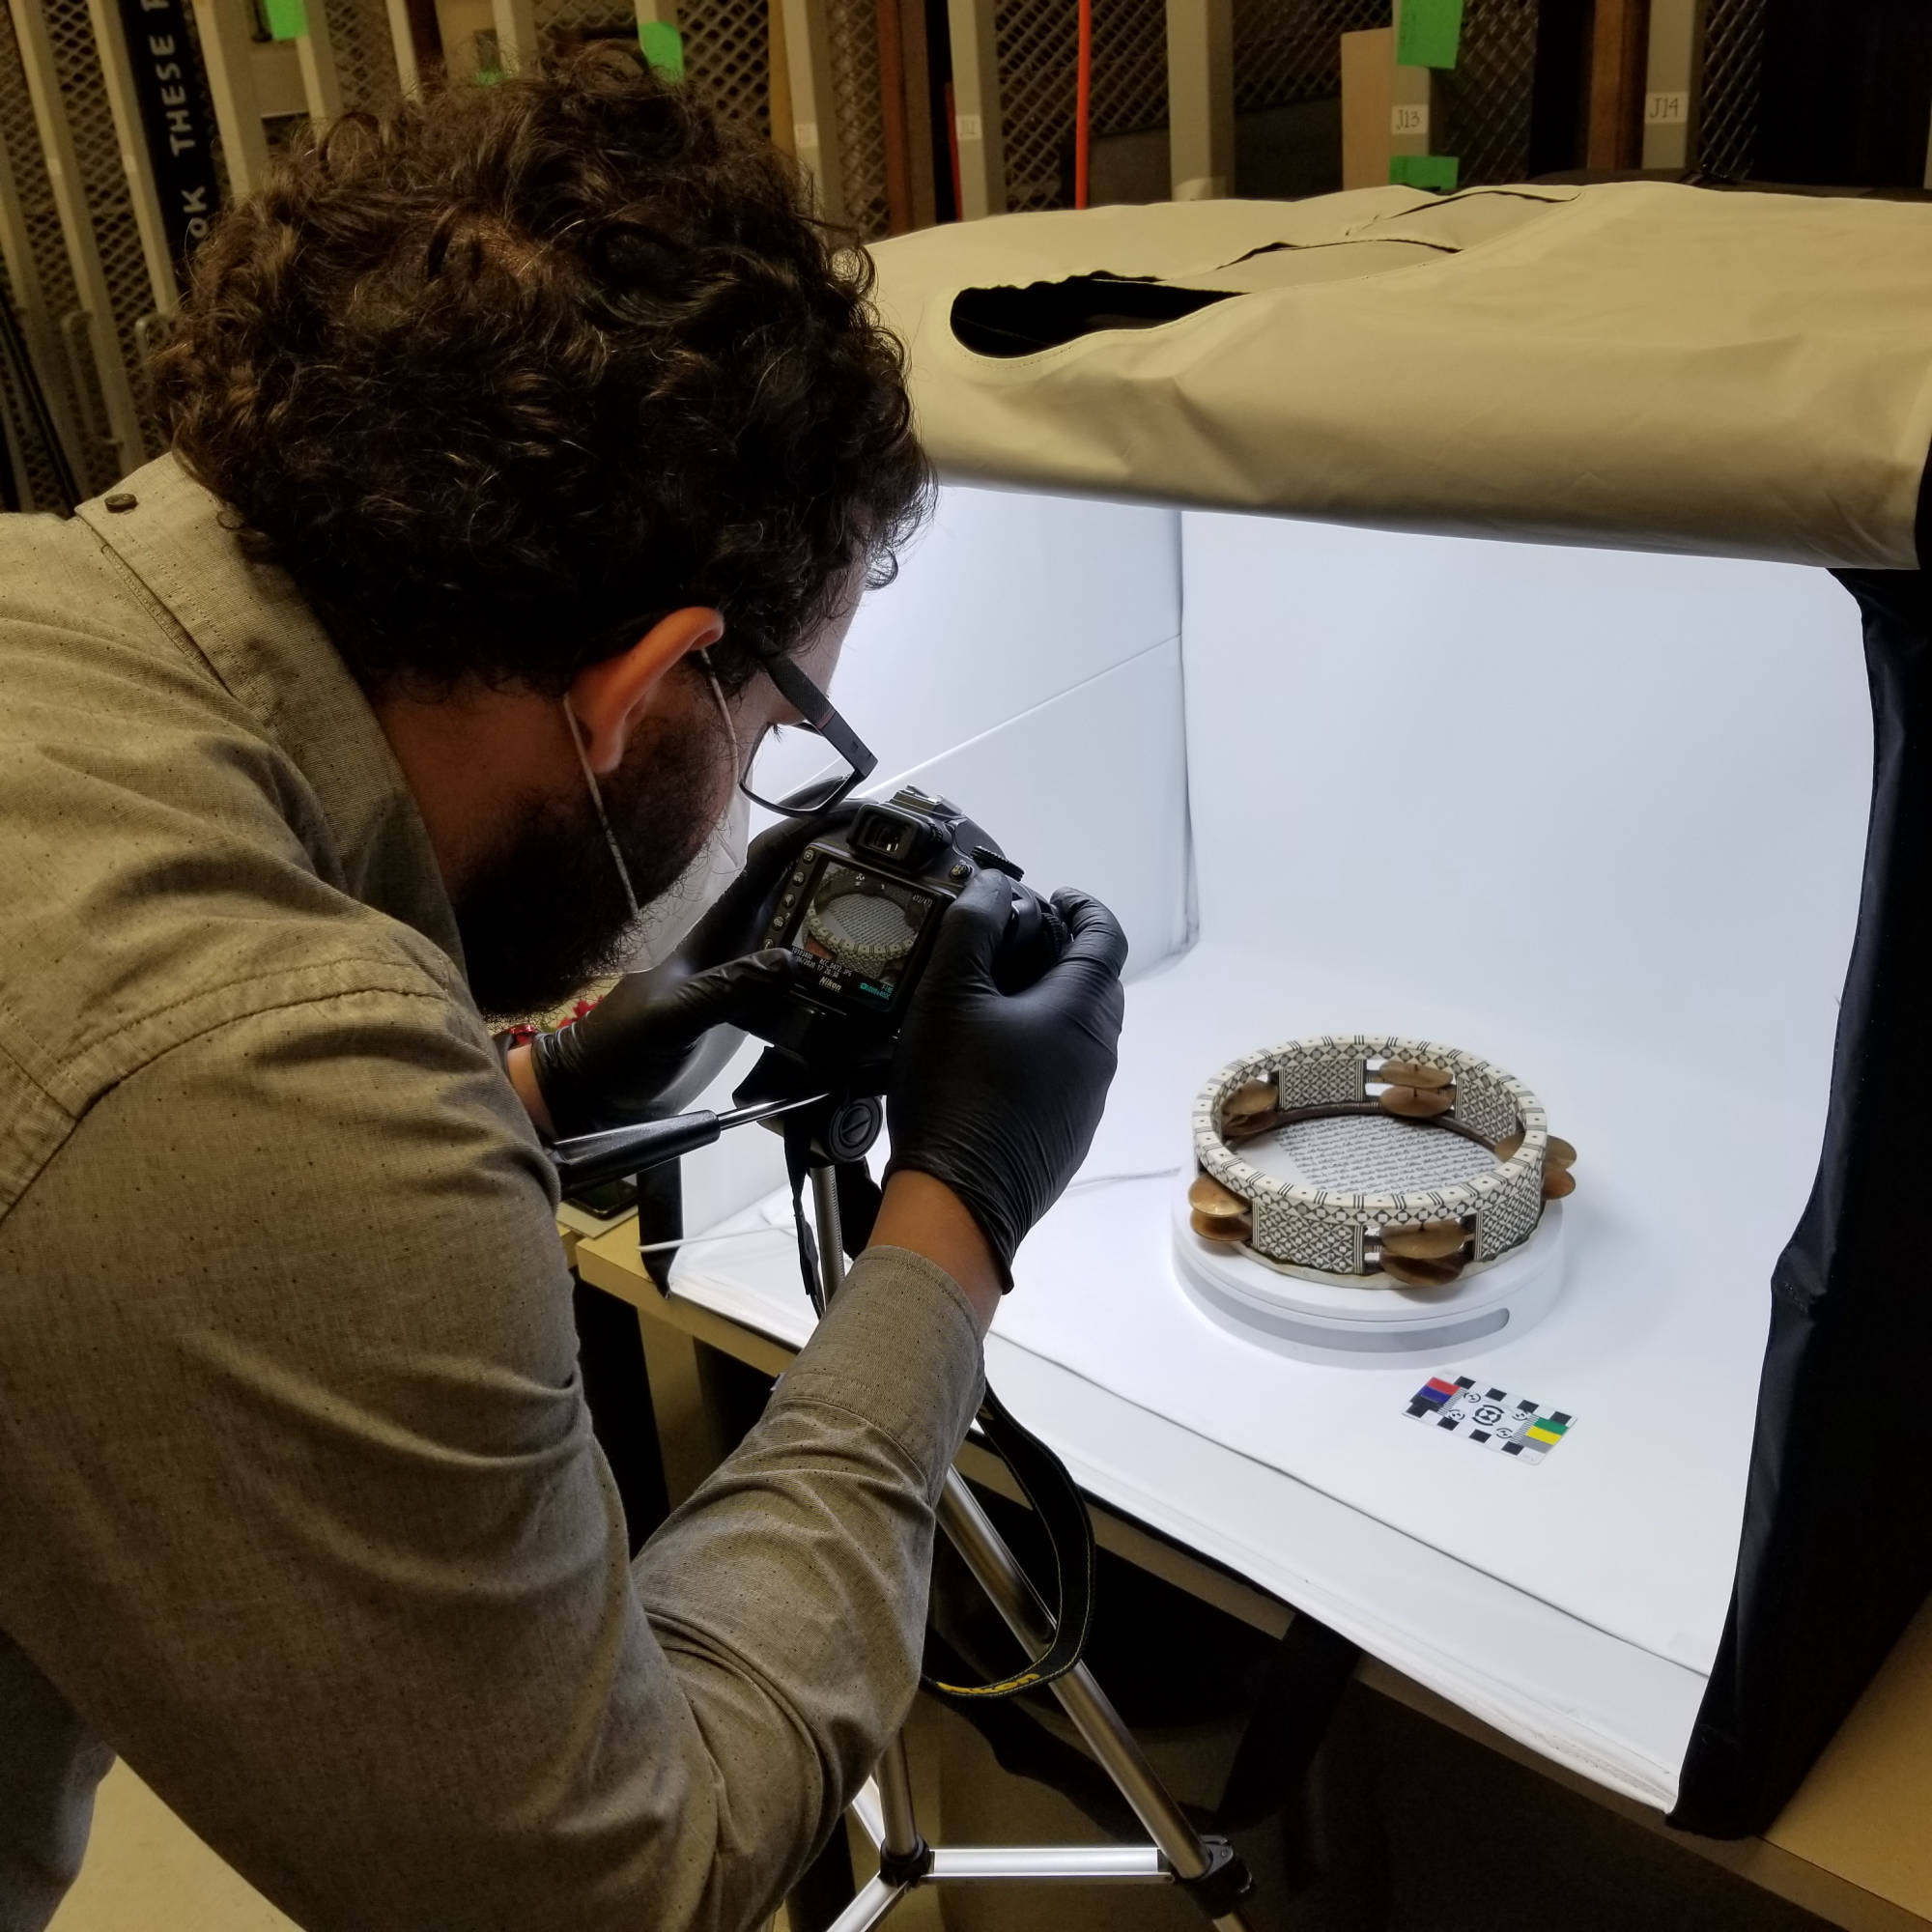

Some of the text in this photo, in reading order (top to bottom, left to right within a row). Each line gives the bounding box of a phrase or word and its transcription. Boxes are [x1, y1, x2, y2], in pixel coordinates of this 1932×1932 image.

[148, 34, 195, 156] THESE
[1650, 98, 1678, 118] J14
[1396, 109, 1420, 129] J13
[181, 185, 210, 249] OK
[819, 977, 841, 993] Nikon
